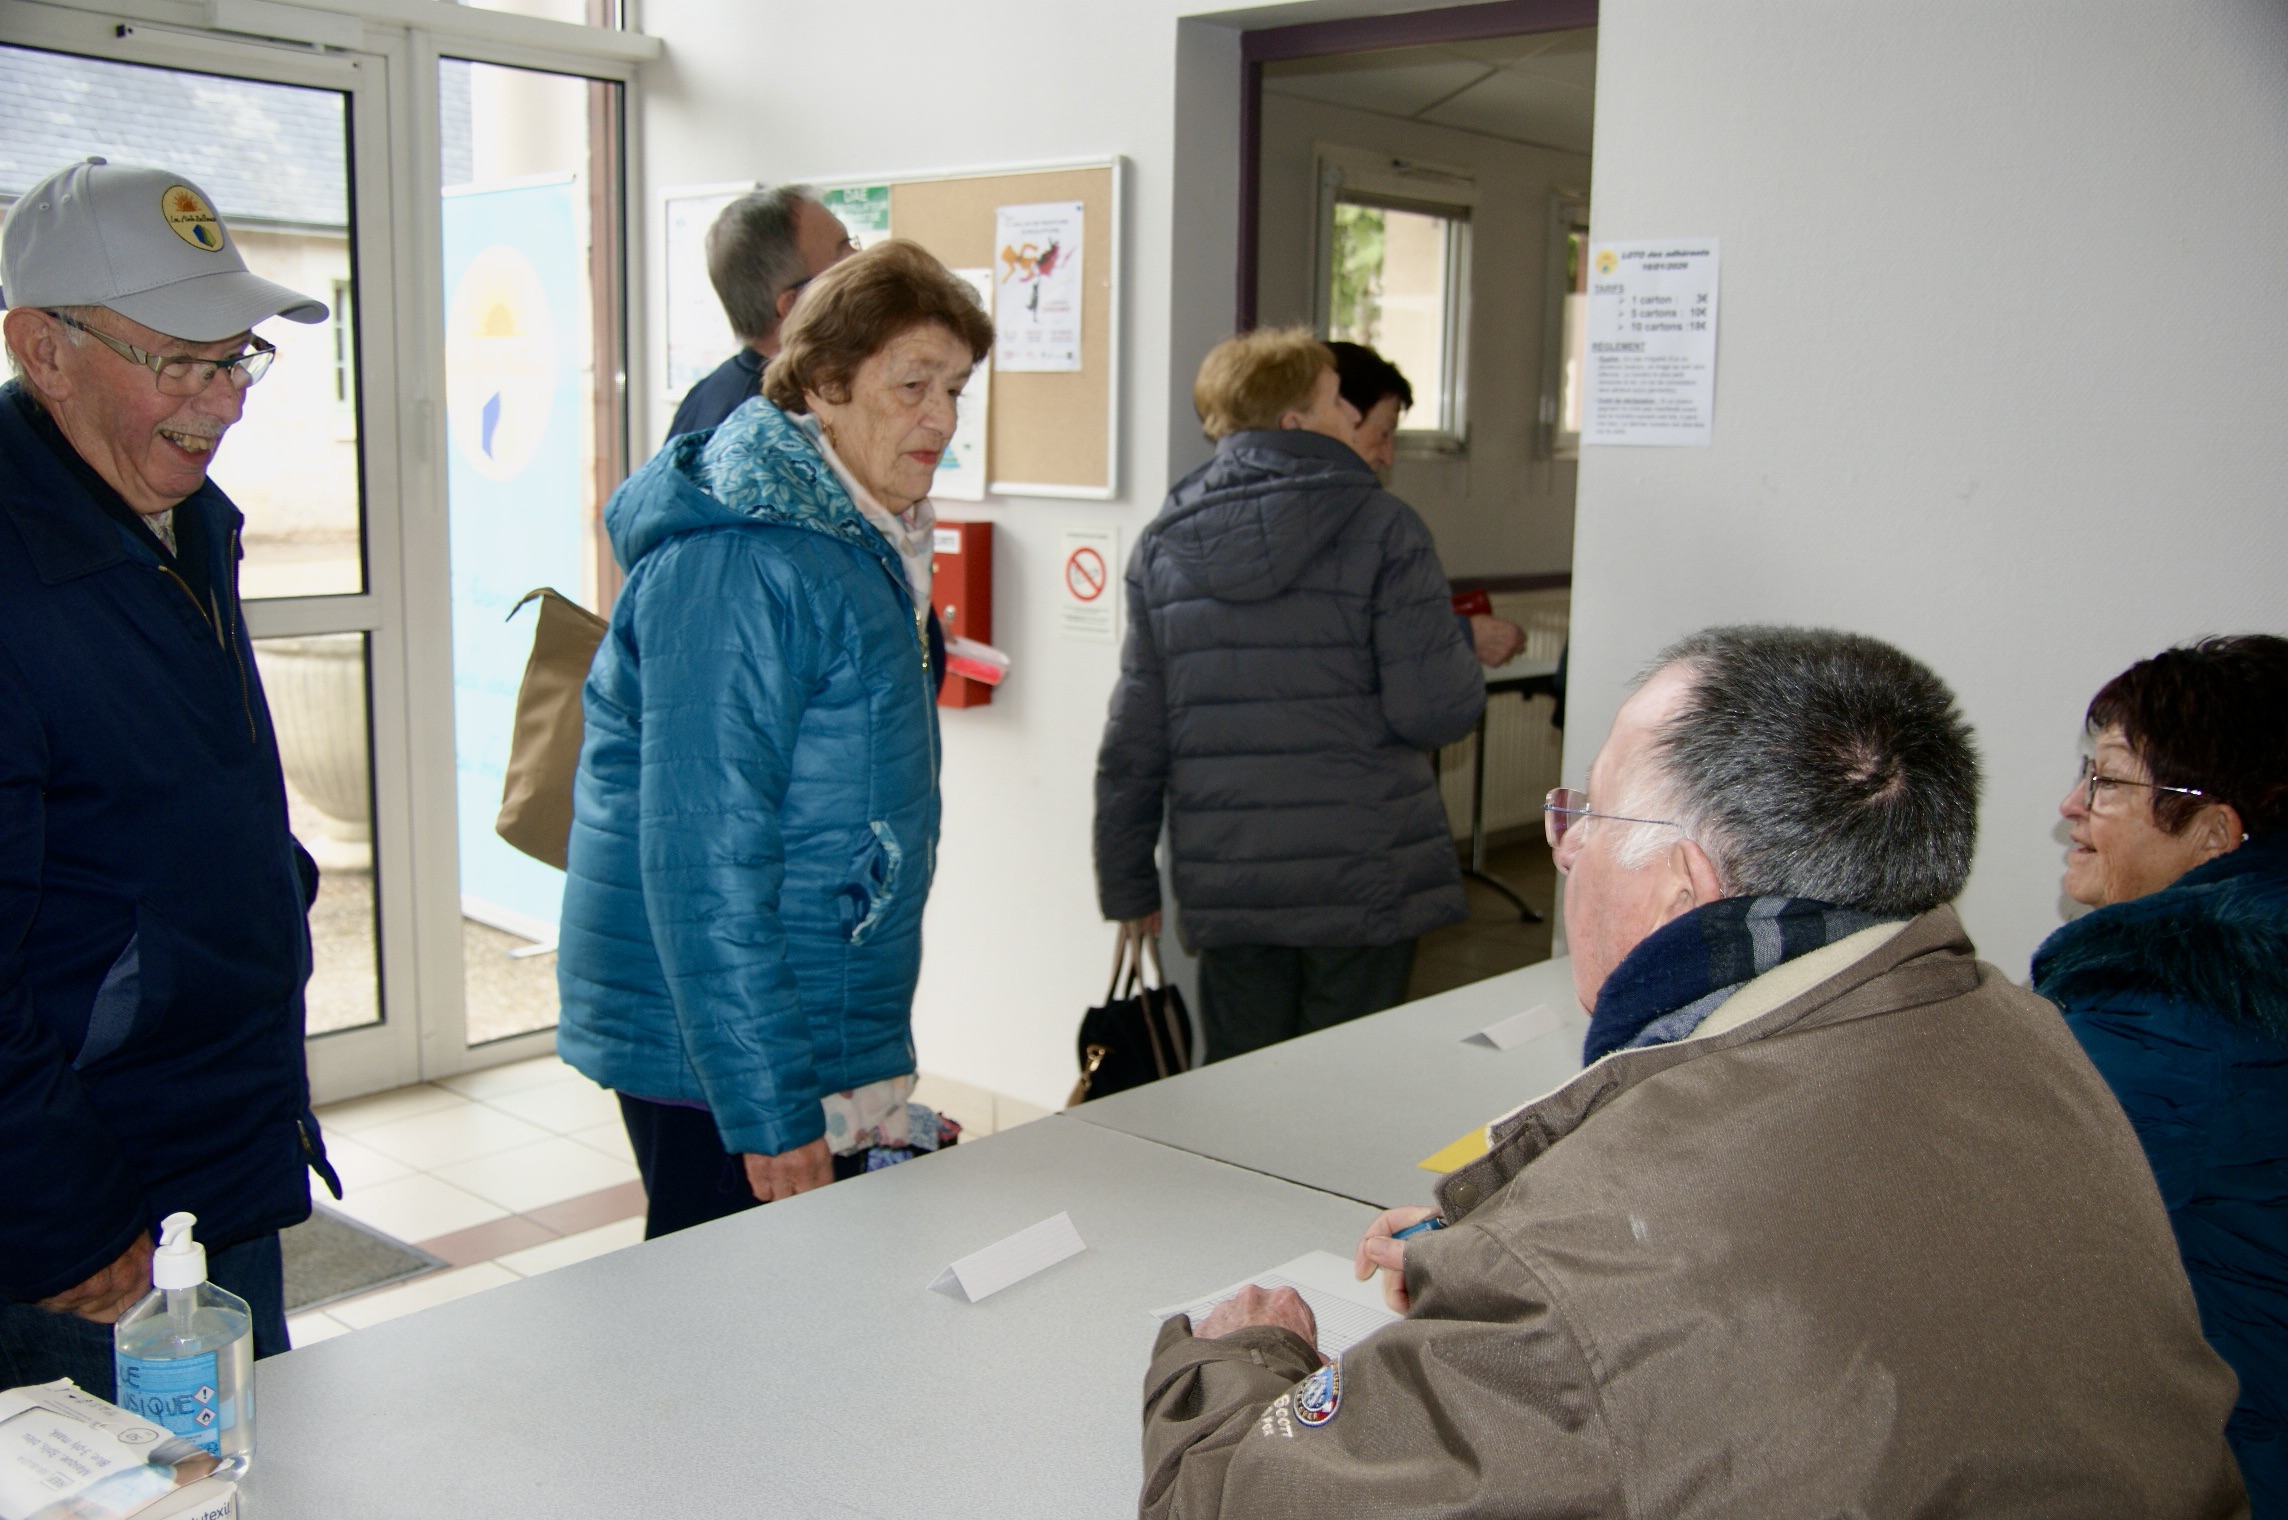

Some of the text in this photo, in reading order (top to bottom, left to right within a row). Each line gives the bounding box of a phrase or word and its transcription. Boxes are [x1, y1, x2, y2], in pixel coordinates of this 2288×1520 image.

[1622, 251, 1646, 260] LOTO
[1640, 296, 1672, 304] carton
[1640, 309, 1677, 318] cartons
[1645, 323, 1683, 332] cartons
